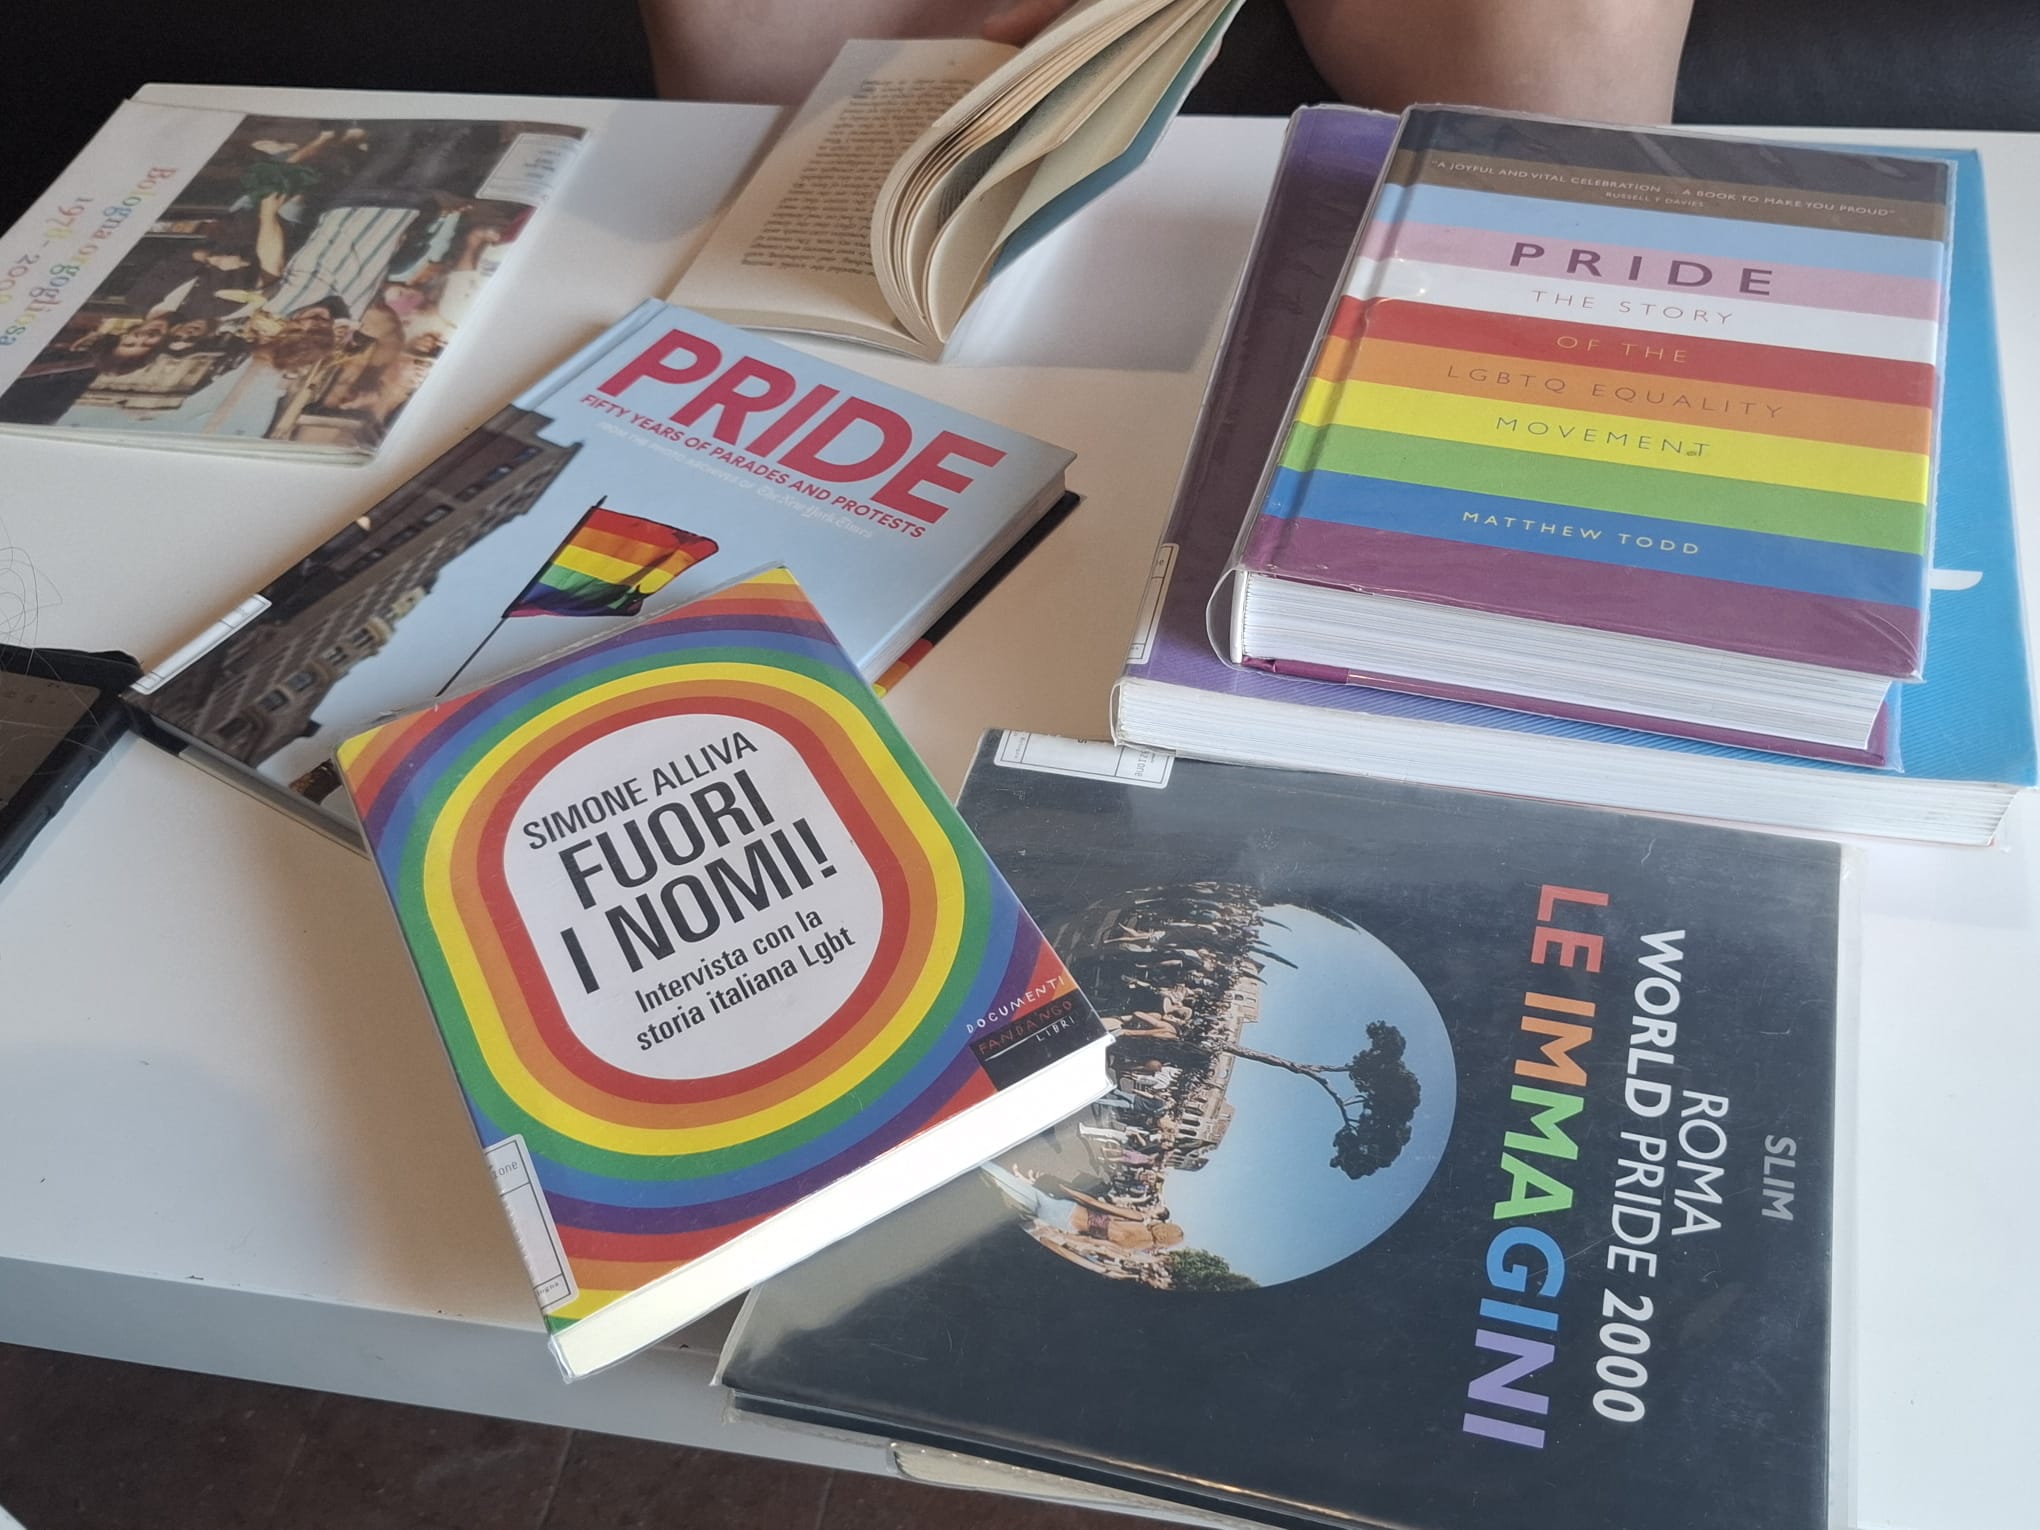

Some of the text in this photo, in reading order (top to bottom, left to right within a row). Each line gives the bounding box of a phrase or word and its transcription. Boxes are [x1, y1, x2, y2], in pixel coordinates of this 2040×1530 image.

[92, 166, 178, 240] Bologna
[1449, 162, 1495, 176] JOYFUL
[1498, 168, 1528, 179] AND
[1531, 172, 1566, 183] VITAL
[1570, 176, 1662, 193] CELEBRATION
[1696, 190, 1737, 201] BOOK
[1740, 195, 1760, 203] TO
[1764, 197, 1802, 208] MAKE
[1804, 201, 1835, 211] YOU
[1605, 191, 1650, 202] RUSSELL
[1509, 240, 1775, 297] PRIDE
[1531, 288, 1736, 326] THE STORY
[1556, 334, 1689, 364] OF THE
[597, 328, 1007, 524] PRIDE
[1447, 364, 1786, 419] LGBTQ EQUALITY
[579, 394, 926, 538] FIFTY YEARS OF PARADES AND PROTESTS
[1495, 416, 1711, 457] MOVEMENT
[1463, 510, 1702, 556] MATTHEW TODD
[522, 731, 759, 850] SIMONE ALLIVA
[558, 769, 775, 910] FUORI
[560, 817, 838, 995] I NOMI!
[634, 908, 823, 1014] Intervista con la
[635, 925, 856, 1051] storia italiana Lgbt
[966, 975, 1065, 1034] DOCUMENTI
[977, 1000, 1074, 1055] FANDANGO
[1035, 1016, 1076, 1043] LIBRI
[1462, 884, 1610, 1450] LE IMMAGINI
[1592, 929, 1687, 1424] WORLD PRIDE 2000
[1671, 1088, 1730, 1237] ROMA
[1761, 1134, 1798, 1222] SLIM
